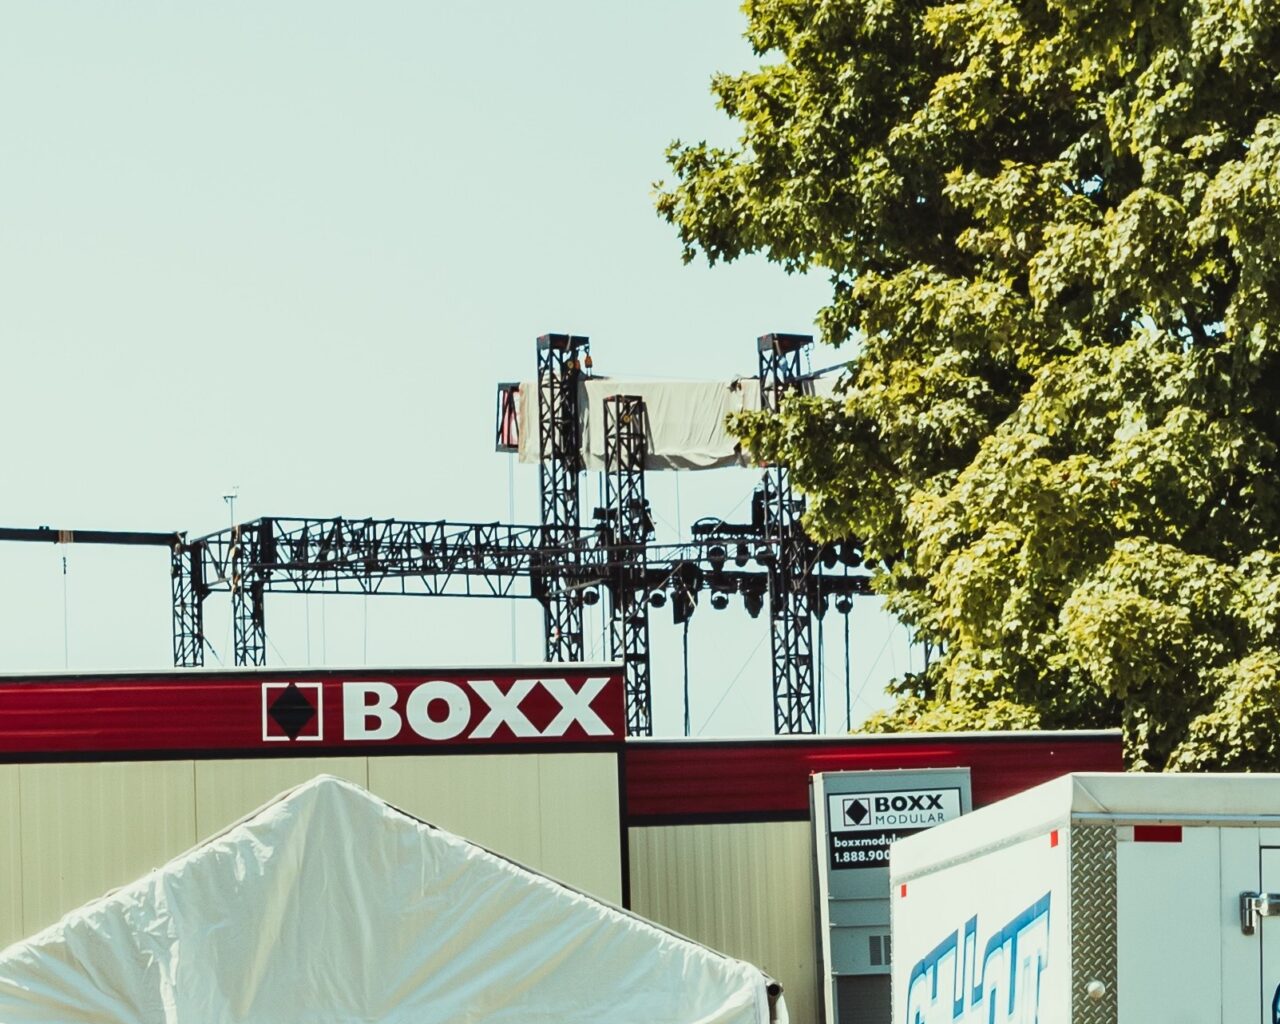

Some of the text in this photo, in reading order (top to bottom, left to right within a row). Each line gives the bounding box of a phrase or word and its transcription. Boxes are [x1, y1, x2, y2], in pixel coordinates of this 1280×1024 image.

[342, 677, 614, 741] BOXX
[875, 794, 944, 812] BOXX
[876, 813, 945, 824] MODULAR
[834, 833, 906, 848] boxxmodul
